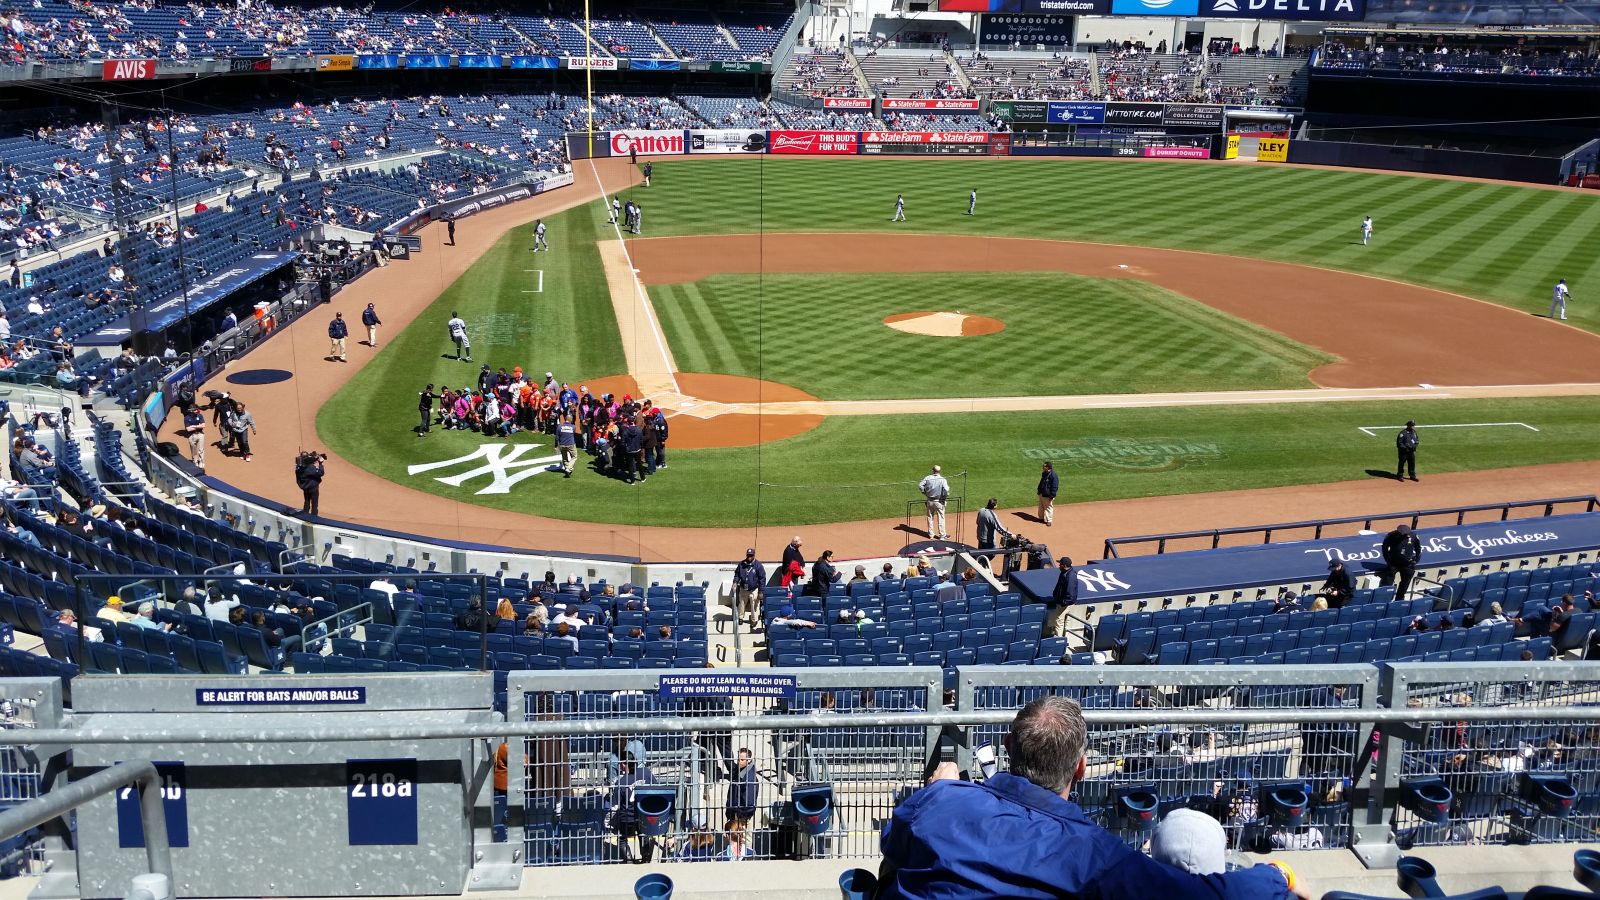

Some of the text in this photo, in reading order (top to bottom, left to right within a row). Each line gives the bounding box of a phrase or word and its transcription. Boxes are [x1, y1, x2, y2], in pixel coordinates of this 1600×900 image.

[1040, 0, 1094, 10] tristateford.com
[113, 60, 146, 79] AVIS
[1106, 108, 1162, 119] NITTOTIRE.COM
[611, 133, 683, 154] Canon
[819, 134, 856, 142] THIS BUD'S
[819, 143, 849, 151] FOR YOU.
[1443, 529, 1559, 556] Yankees
[662, 677, 689, 685] PLEASE
[690, 677, 698, 685] DO
[701, 677, 716, 685] NOT
[717, 677, 734, 685] LEAN
[749, 677, 772, 686] REACH
[706, 686, 730, 694] STAND
[731, 686, 749, 694] NEAR
[751, 686, 785, 694] RAILINGS.
[202, 690, 359, 702] BE ALERT FOR BATS AND/OR BALLS
[351, 772, 412, 798] 218a
